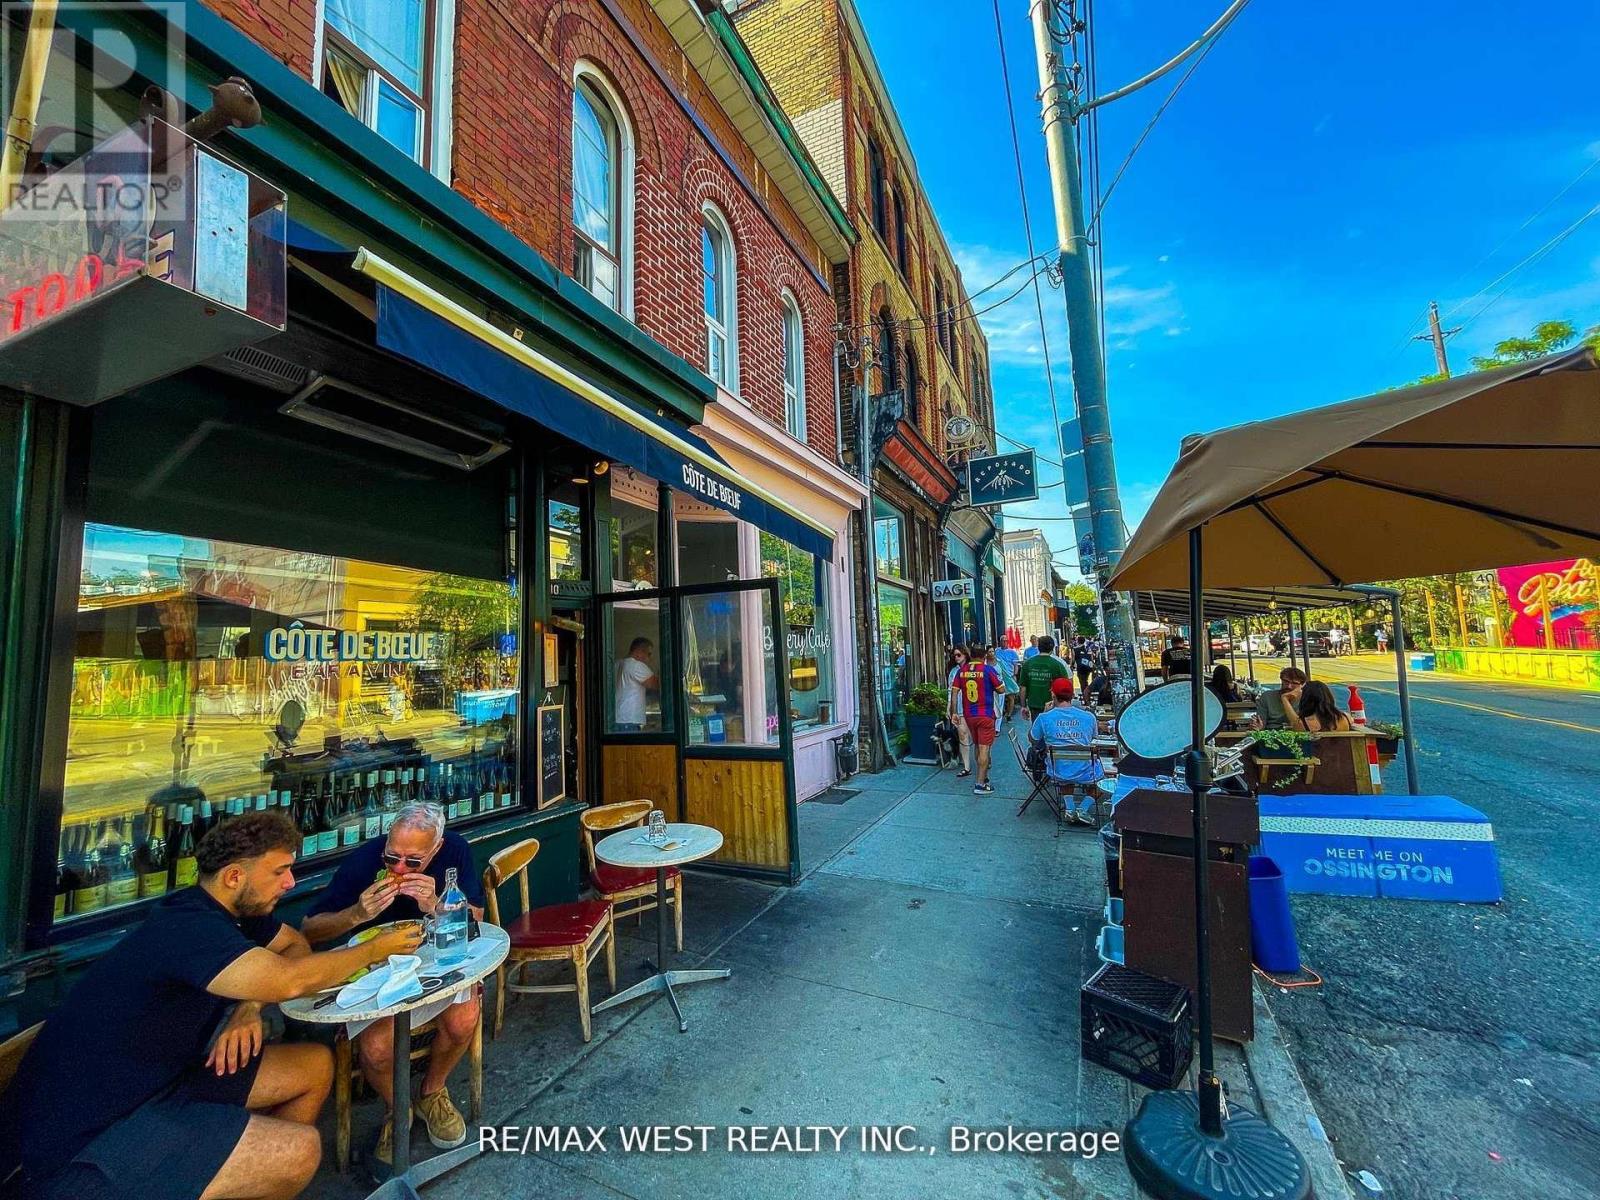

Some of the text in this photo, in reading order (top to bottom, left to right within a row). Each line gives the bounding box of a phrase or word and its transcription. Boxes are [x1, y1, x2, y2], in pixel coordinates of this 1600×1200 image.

[682, 463, 706, 494] CÔTE
[707, 477, 720, 500] DE
[974, 460, 1031, 483] REPOSADO
[934, 582, 972, 598] SAGE
[266, 619, 337, 662] CÔTE
[341, 630, 373, 662] DE
[366, 661, 406, 679] VIN
[965, 679, 979, 703] 8
[1326, 847, 1365, 860] MEET
[1400, 851, 1423, 863] ON
[1303, 858, 1454, 885] OSSINGTON
